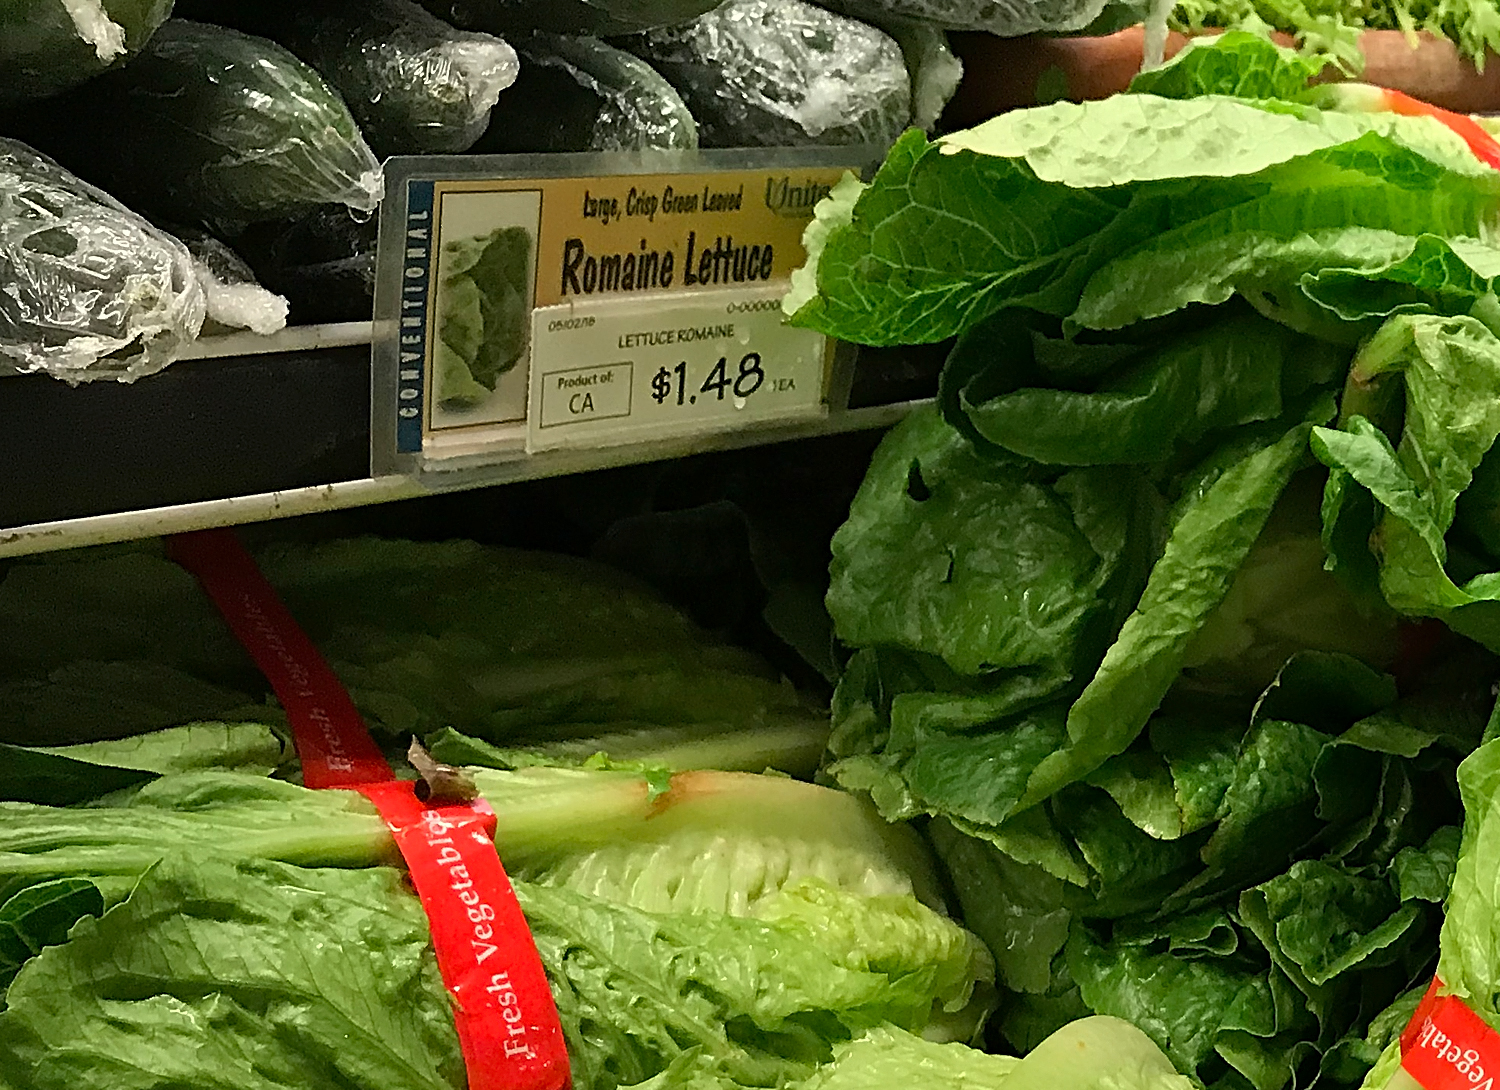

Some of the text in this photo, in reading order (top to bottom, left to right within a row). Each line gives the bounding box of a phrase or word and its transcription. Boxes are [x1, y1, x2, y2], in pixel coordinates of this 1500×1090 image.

[626, 187, 658, 222] Crisp
[661, 186, 699, 215] Green
[560, 231, 774, 296] Romaine Lettuce
[398, 208, 431, 420] CONVENTIONAL
[618, 323, 736, 349] LETTUCE ROMAINE
[557, 373, 598, 390] Product
[651, 351, 766, 406] $1.48
[568, 392, 595, 415] CA
[483, 970, 531, 1062] Fresh
